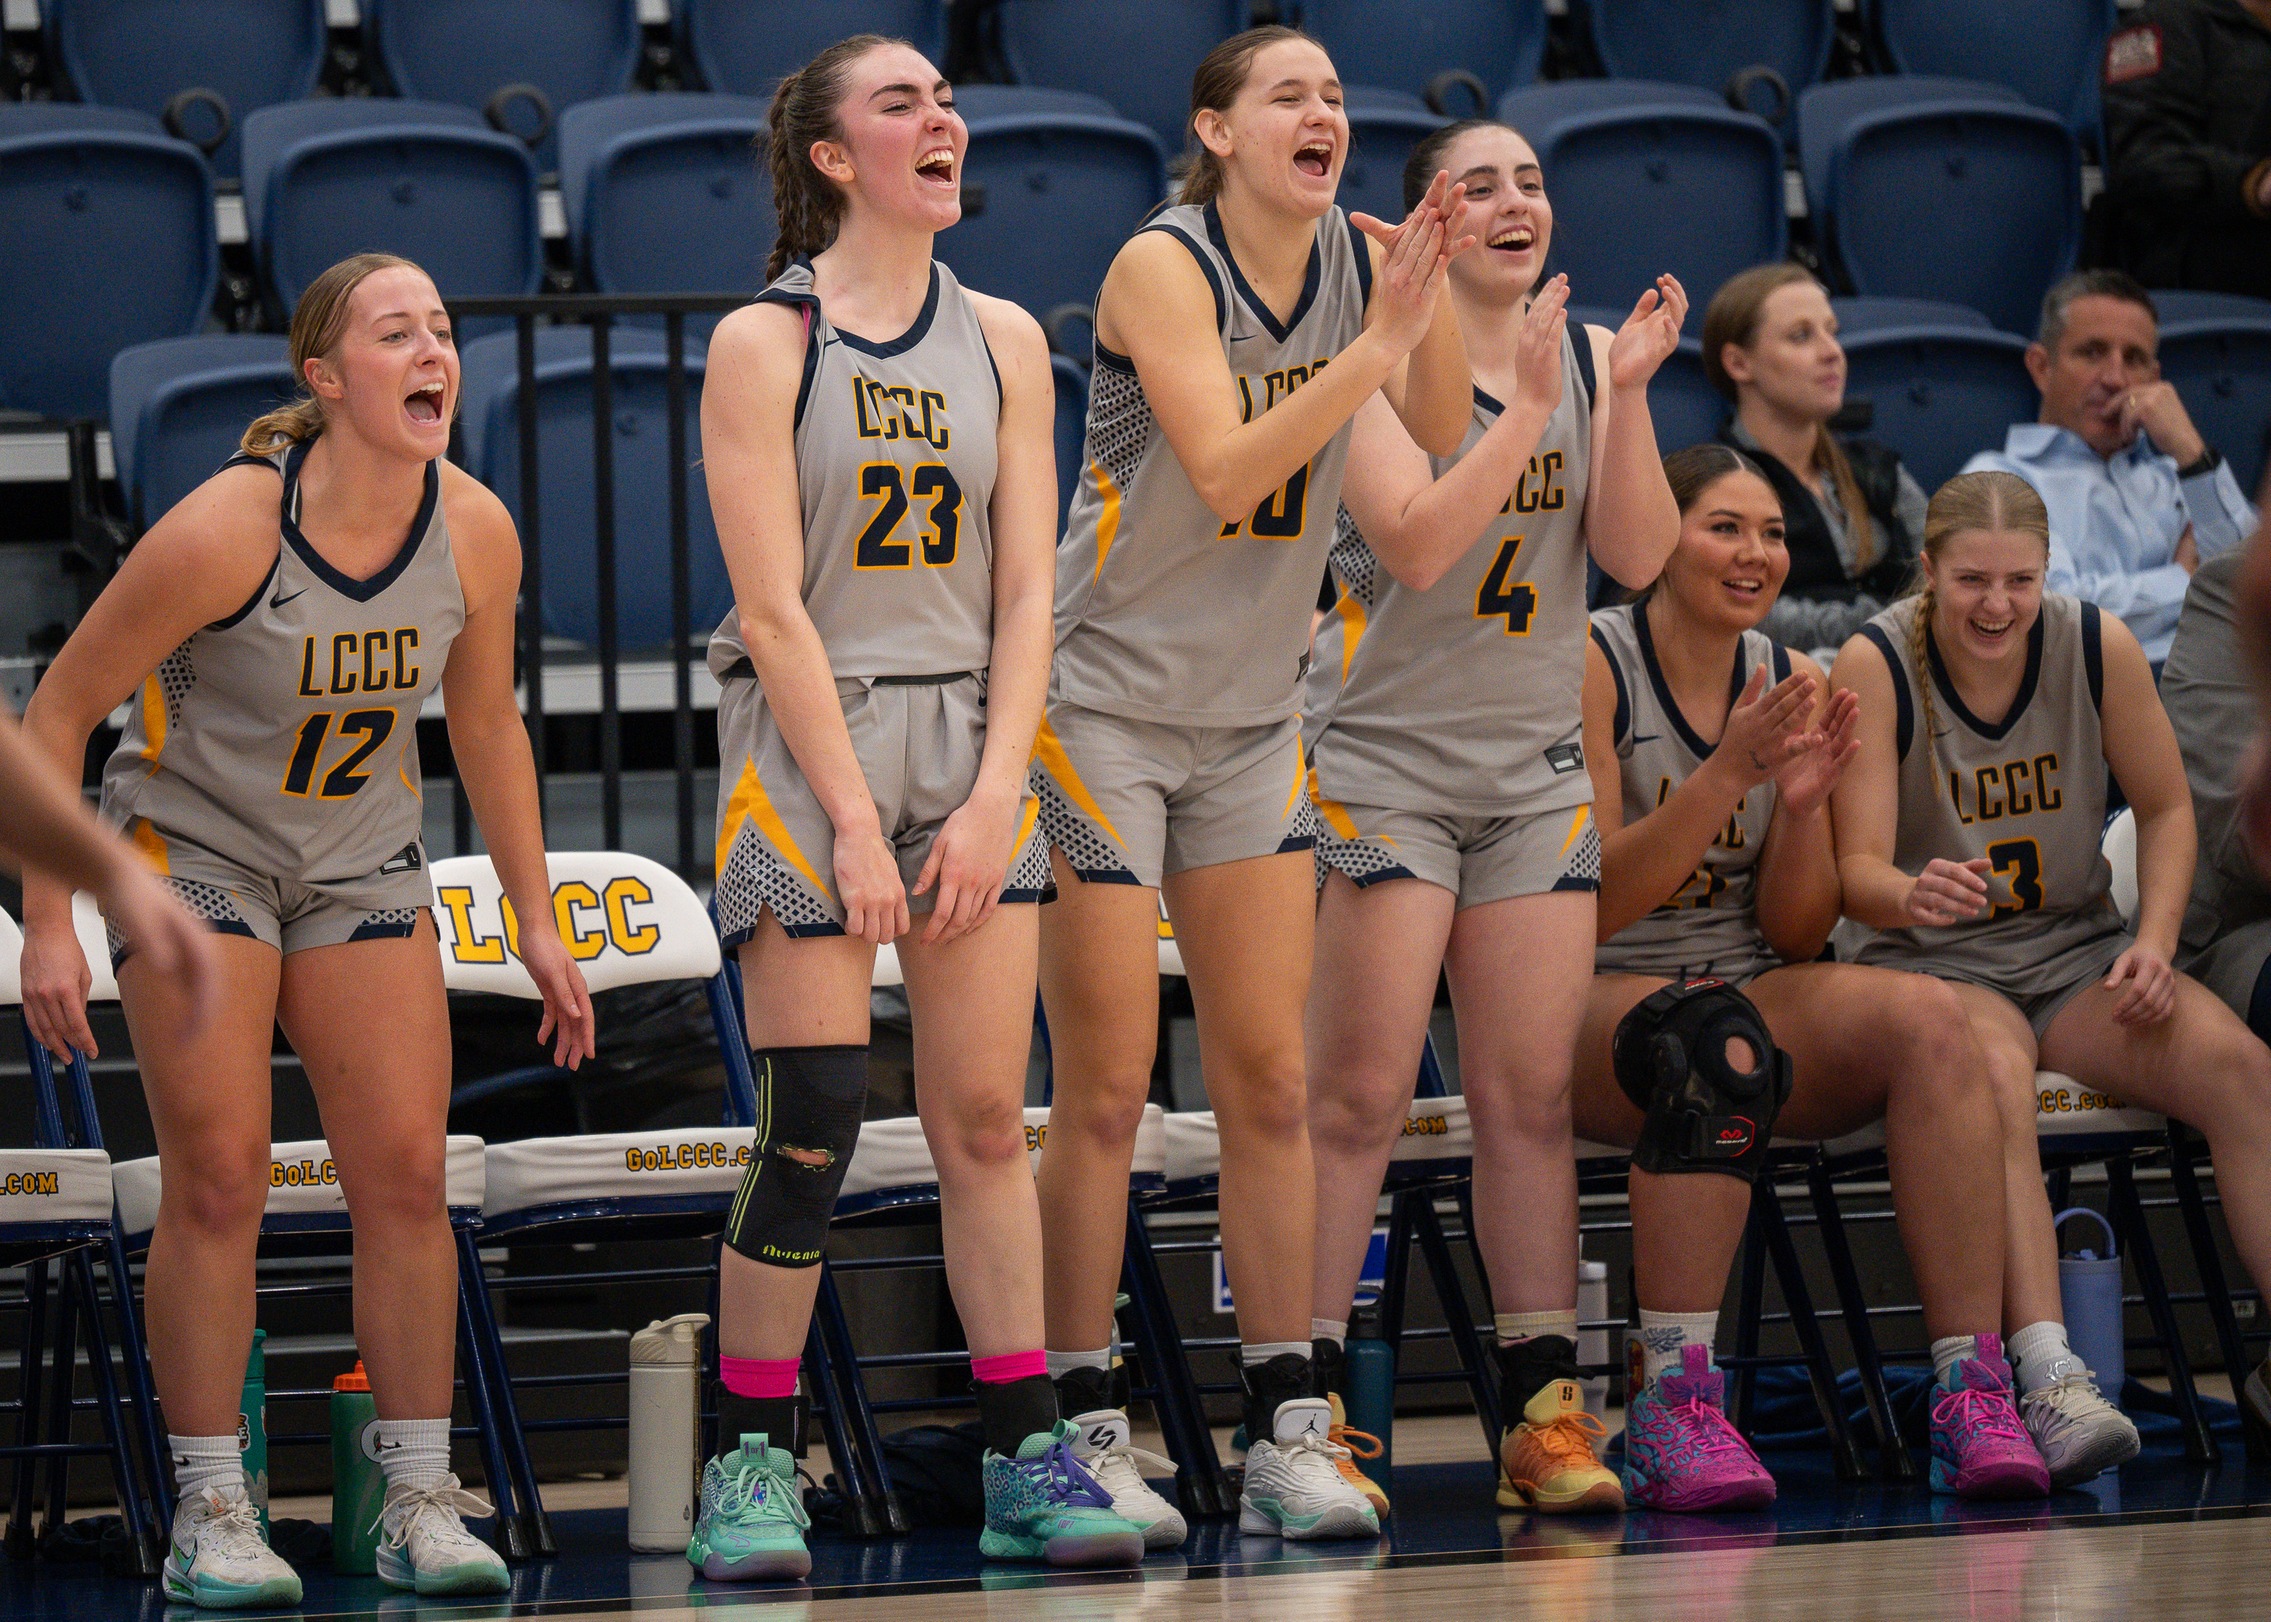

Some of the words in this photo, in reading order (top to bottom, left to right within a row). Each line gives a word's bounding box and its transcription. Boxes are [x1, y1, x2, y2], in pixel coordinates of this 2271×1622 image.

[852, 375, 949, 452] LCCC
[1237, 357, 1330, 425] LC
[852, 460, 965, 571] 23
[1216, 457, 1312, 542] 0
[1498, 449, 1567, 517] CC
[1473, 535, 1540, 637] 4
[298, 626, 420, 698] LCCC
[280, 706, 399, 800] 12
[1949, 752, 2063, 825] LCCC
